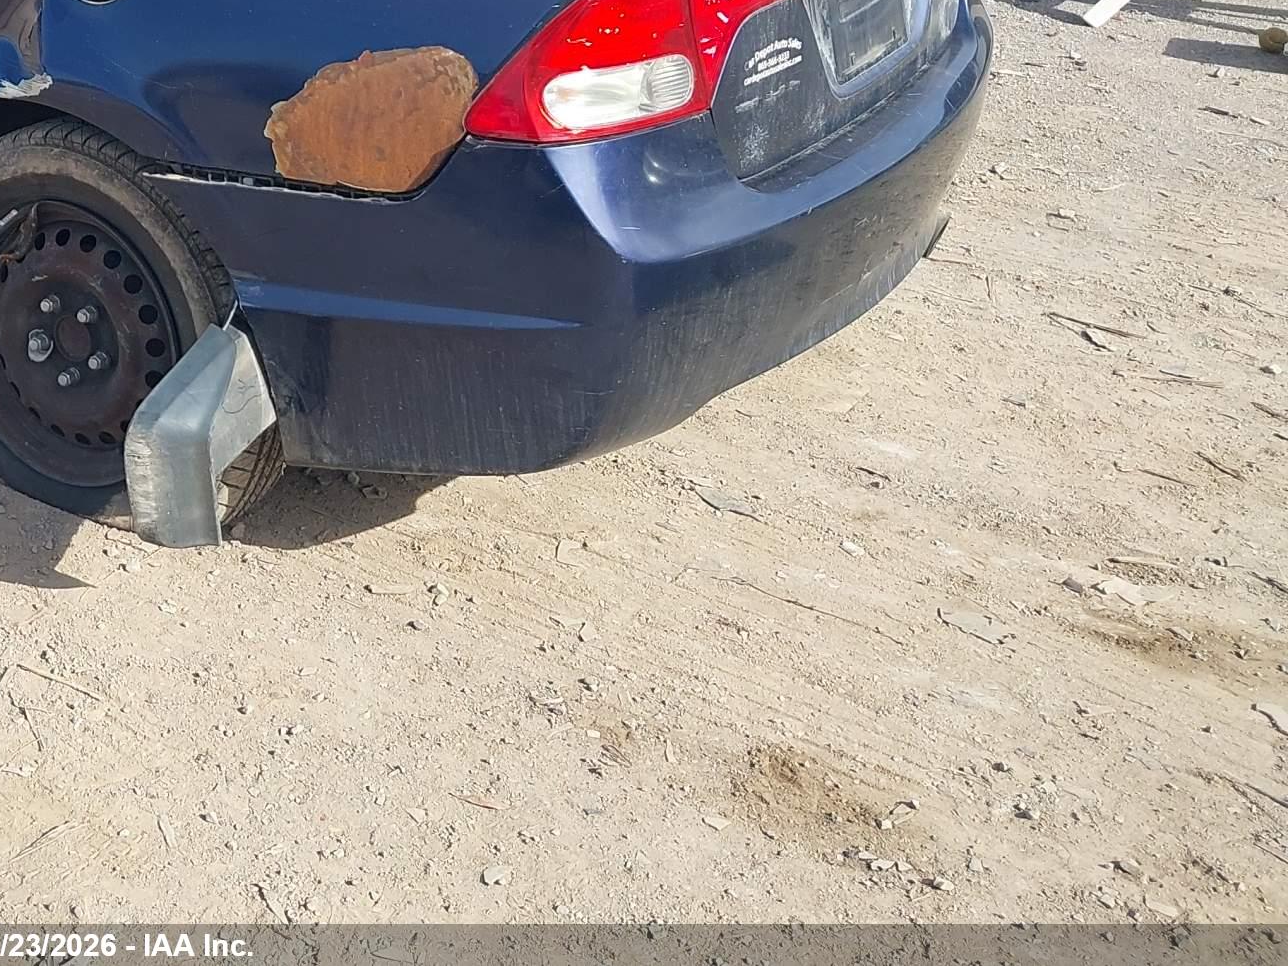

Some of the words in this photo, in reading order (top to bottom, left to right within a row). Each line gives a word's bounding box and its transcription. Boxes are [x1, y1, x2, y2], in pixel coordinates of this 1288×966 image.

[754, 43, 774, 63] Depot
[774, 39, 787, 50] Auto
[787, 37, 802, 50] Sales
